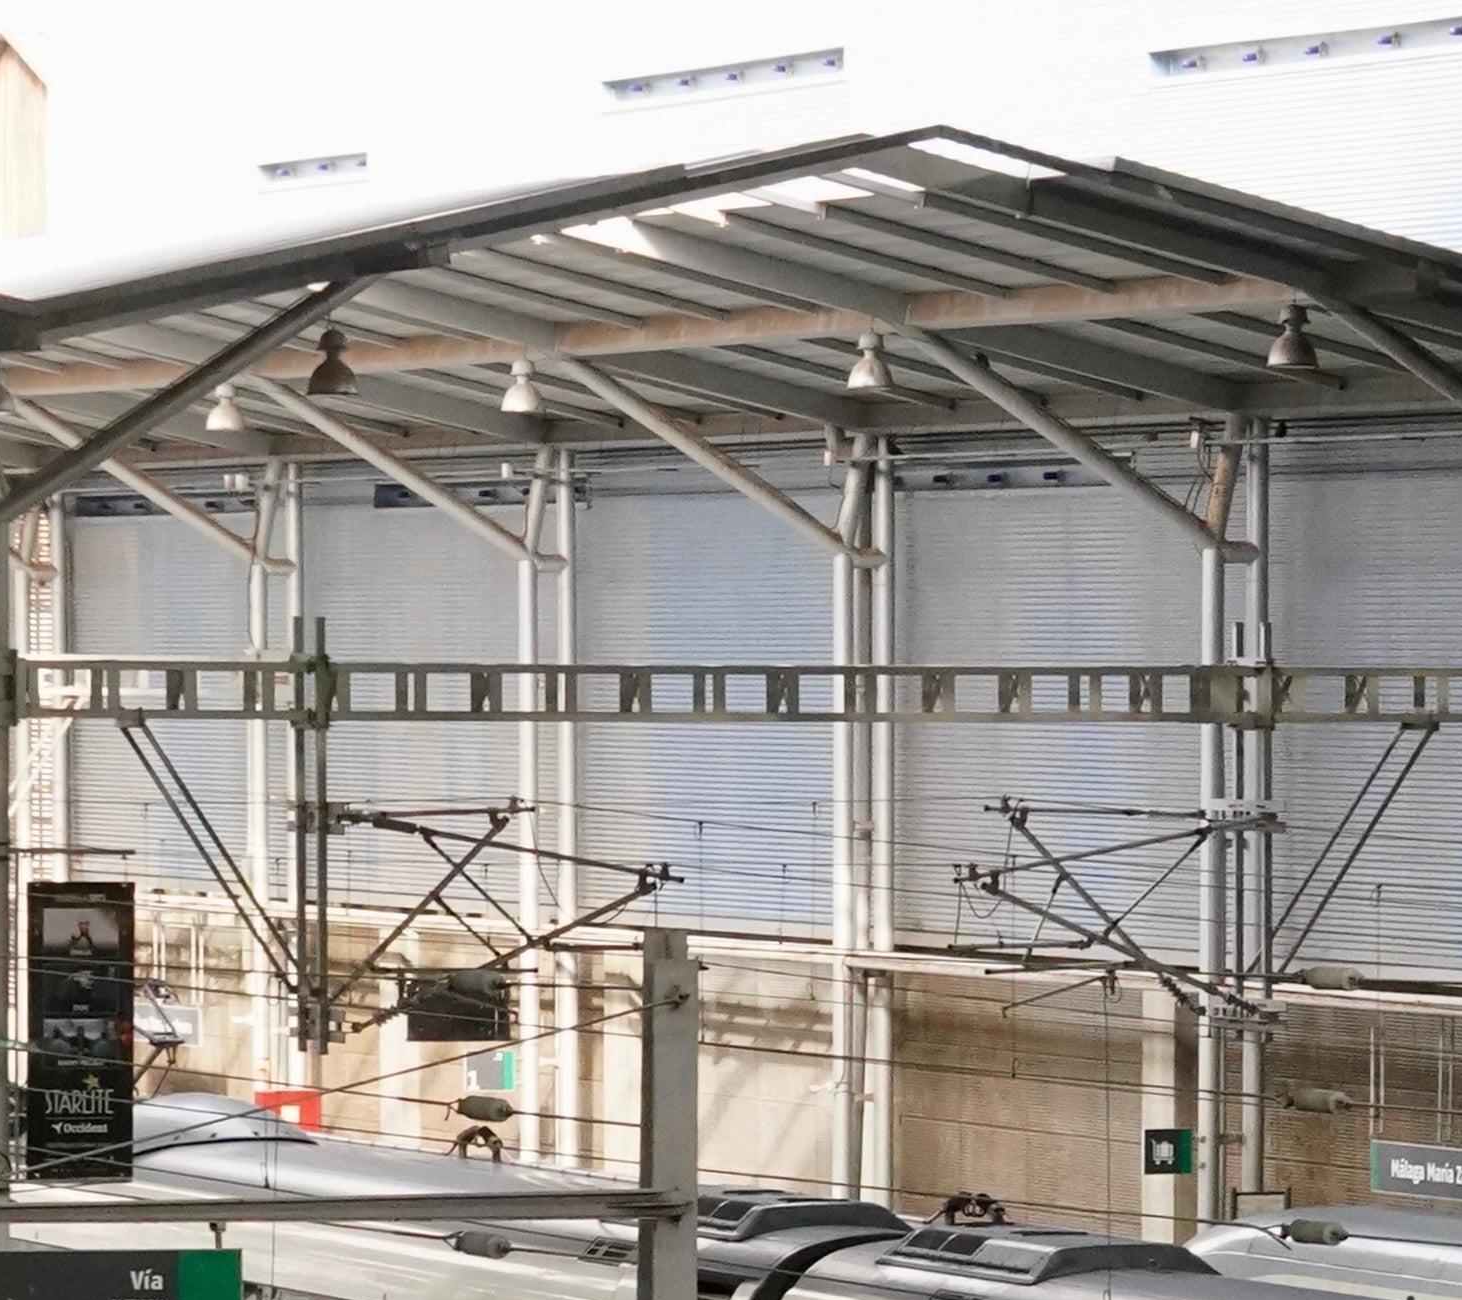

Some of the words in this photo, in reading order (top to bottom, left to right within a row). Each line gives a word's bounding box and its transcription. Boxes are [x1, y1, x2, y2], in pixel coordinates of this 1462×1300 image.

[467, 1070, 480, 1090] 1
[45, 1089, 114, 1114] STARLITE
[1391, 1158, 1425, 1184] Málaga
[1427, 1162, 1454, 1183] María
[130, 1268, 164, 1291] Vía
